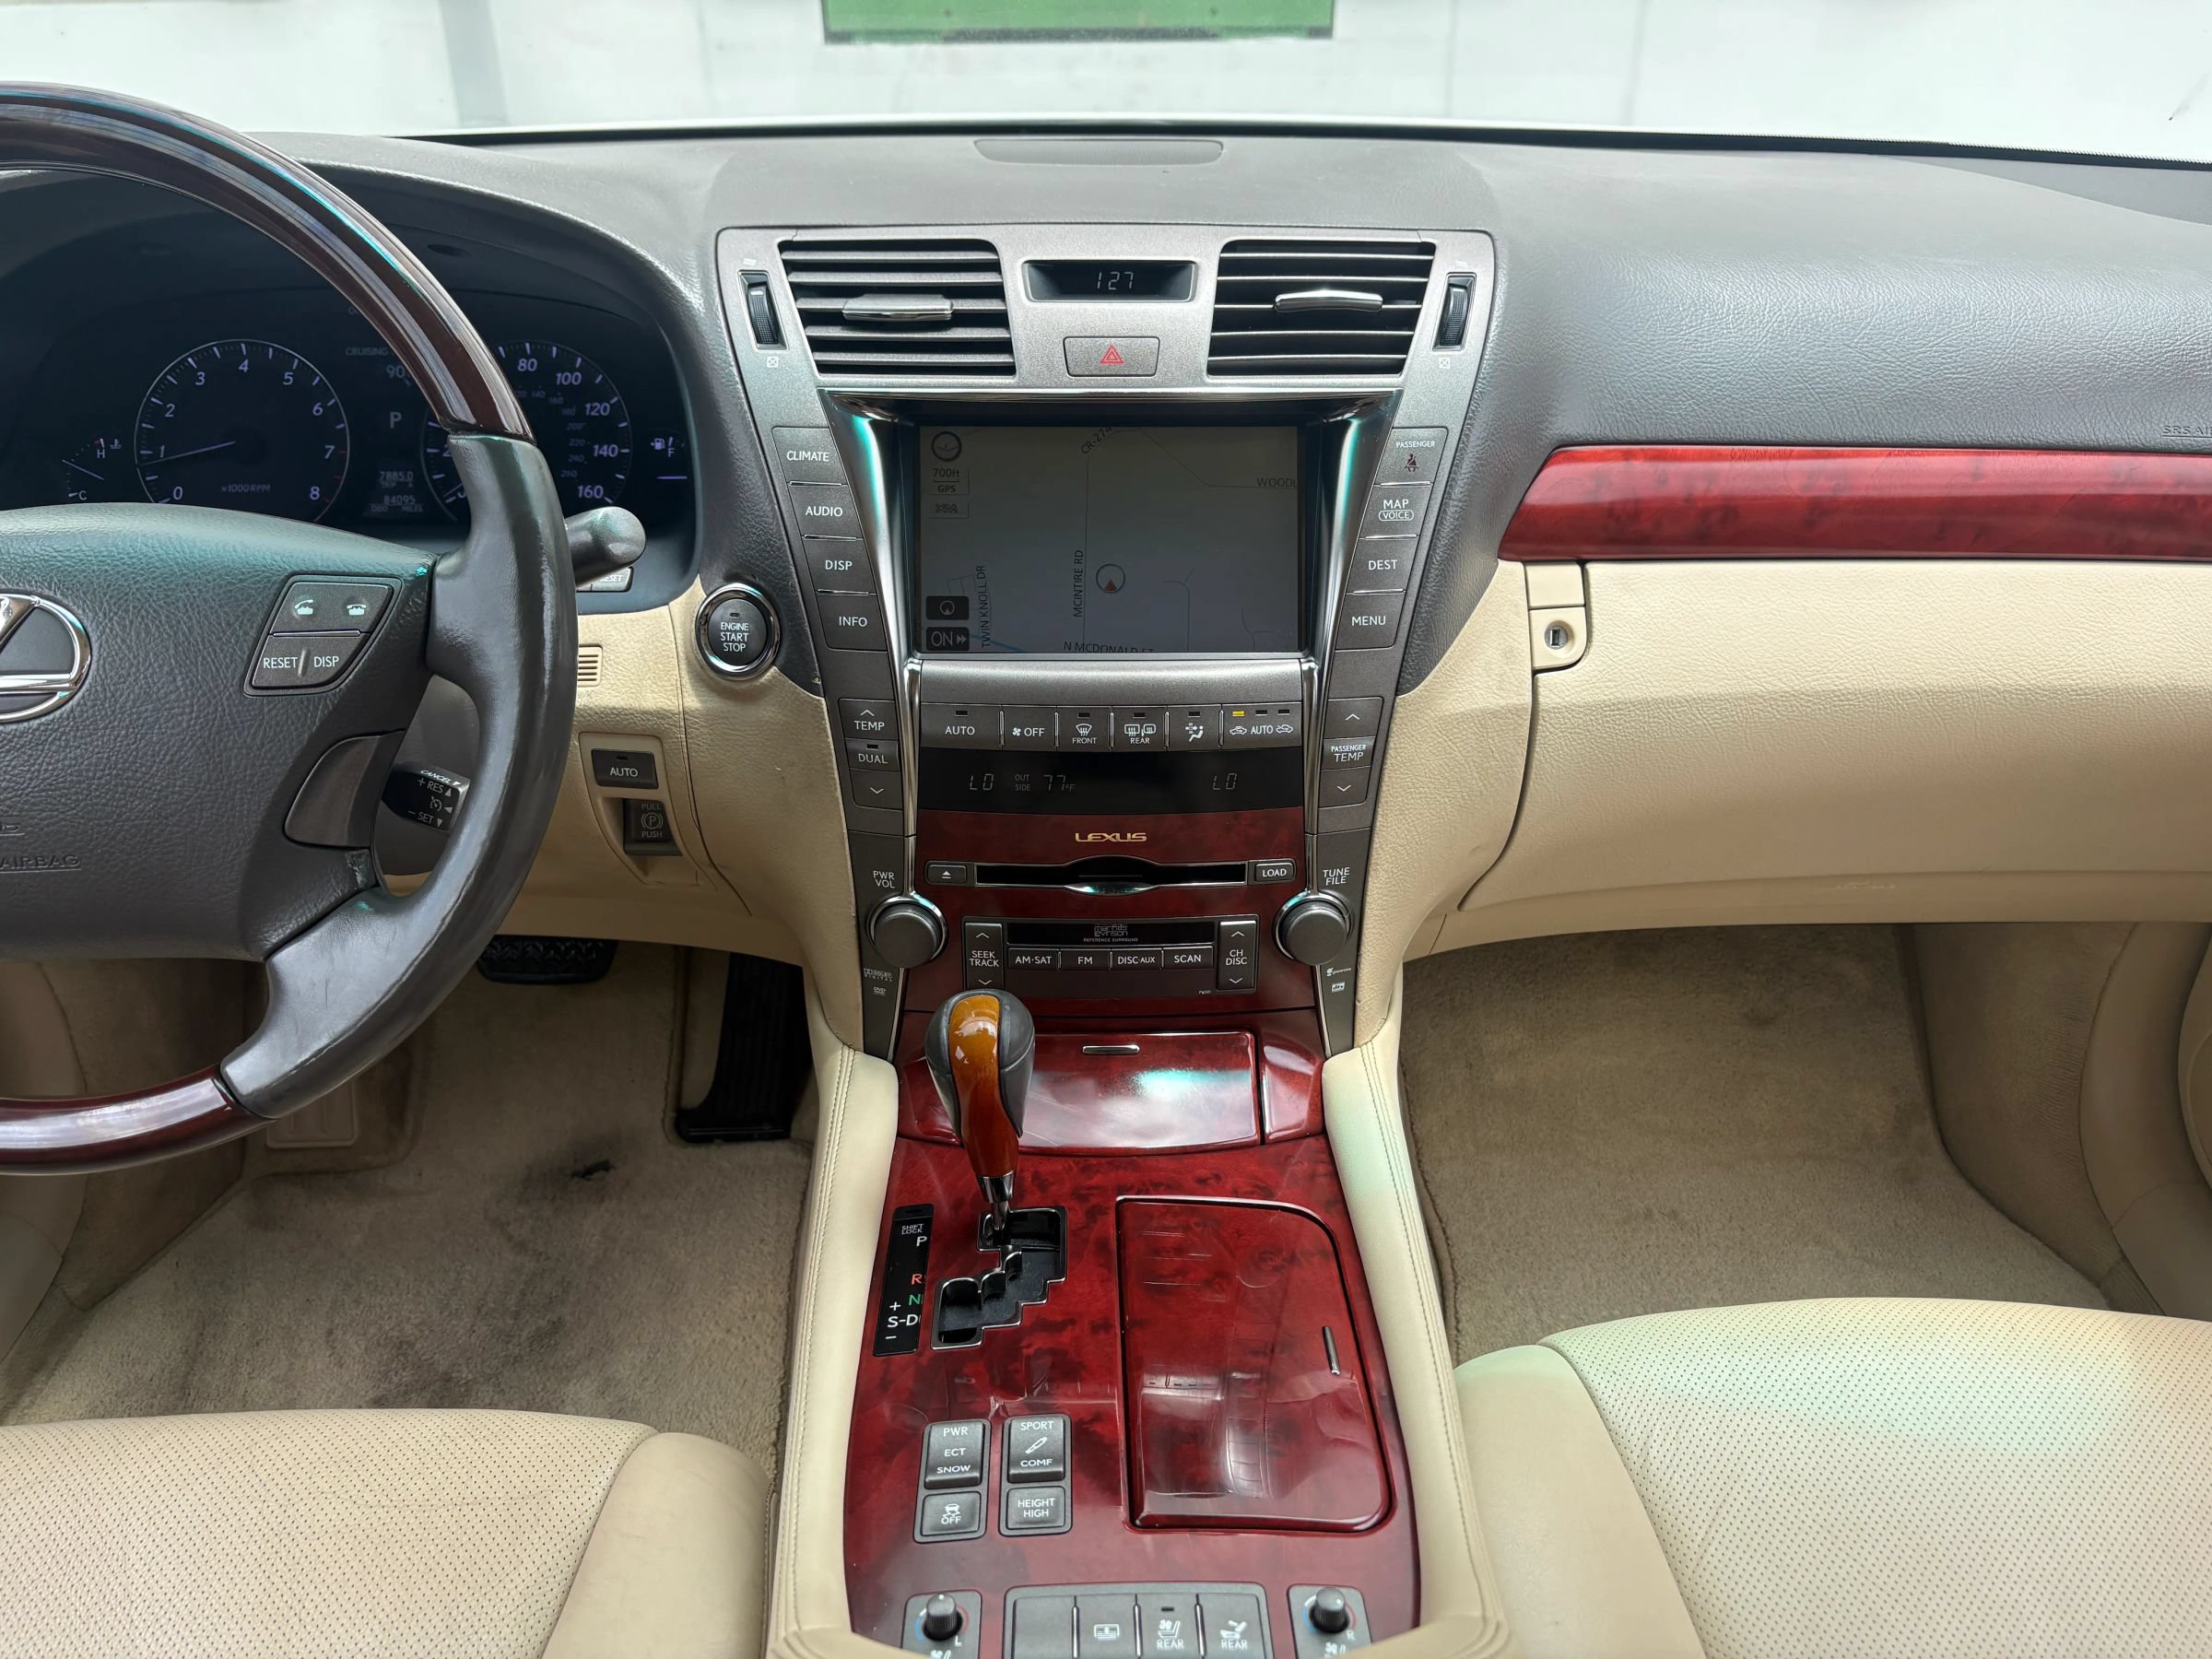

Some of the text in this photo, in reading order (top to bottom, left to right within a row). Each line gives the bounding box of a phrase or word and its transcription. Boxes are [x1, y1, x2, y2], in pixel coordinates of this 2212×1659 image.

[239, 359, 249, 372] 4
[517, 359, 538, 371] 80
[195, 372, 206, 385] 3
[283, 372, 294, 385] 5
[556, 372, 582, 385] 100
[165, 404, 175, 417] 2
[312, 403, 323, 416] 6
[584, 403, 610, 416] 120
[390, 412, 402, 428] P
[2163, 425, 2212, 435] SRS AI
[97, 449, 105, 458] H
[159, 445, 166, 457] 1
[324, 445, 335, 459] 7
[593, 444, 619, 457] 140
[667, 448, 675, 458] F
[786, 451, 830, 463] CLIMATE
[172, 487, 183, 500] 0
[310, 487, 320, 500] 8
[578, 486, 604, 499] 160
[937, 485, 957, 493] GPS
[79, 490, 87, 500] C
[1383, 499, 1409, 509] MAP
[806, 506, 843, 517] AUDIO
[1382, 511, 1410, 520] VOICE
[825, 559, 853, 571] DISP
[1368, 559, 1397, 571] DEST
[1073, 549, 1084, 618] MCINTIRE RD
[977, 565, 991, 648] TWIN KNOLL DR
[839, 616, 868, 628] INFO
[1351, 615, 1386, 626] MENU
[720, 622, 749, 631] ENGINE
[720, 632, 749, 642] START
[931, 630, 953, 646] ON
[723, 642, 746, 653] STOP
[1064, 641, 1072, 651] N
[264, 656, 298, 669] RESET
[313, 655, 340, 668] DISP
[854, 720, 886, 731] TEMP
[945, 726, 975, 735] AUTO
[1251, 725, 1274, 735] AUTO
[1024, 727, 1045, 736] OFF
[1331, 744, 1367, 752] PASSENGER
[858, 753, 888, 764] DUAL
[1334, 752, 1364, 762] TEMP
[420, 770, 453, 784] CANCEL
[609, 767, 639, 778] AUTO
[427, 781, 444, 794] RES
[641, 803, 663, 811] PULL
[418, 811, 434, 825] SET
[641, 830, 663, 839] PUSH
[1076, 832, 1147, 842] LEXUS
[0, 854, 81, 869] AIRBAG
[873, 870, 895, 881] PWR
[1263, 868, 1287, 877] LOAD
[1323, 867, 1350, 877] TUNE
[876, 878, 895, 888] VOL
[1325, 876, 1347, 886] FILE
[972, 950, 995, 959] SEEK
[1174, 954, 1201, 963] SCAN
[1230, 949, 1243, 958] CH
[970, 958, 1000, 968] TRACK
[1077, 957, 1093, 965] FM
[1226, 957, 1248, 966] DISC
[916, 1236, 927, 1247] P
[912, 1273, 923, 1285] R
[909, 1293, 921, 1305] N
[1020, 1420, 1054, 1430] SPORT
[943, 1427, 968, 1437] PWR
[944, 1448, 966, 1457] ECT
[1020, 1459, 1053, 1467] COMF
[936, 1465, 971, 1474] SNOW
[1018, 1498, 1055, 1508] HEIGHT
[1023, 1509, 1049, 1519] HIGH
[941, 1515, 962, 1525] OFF
[1157, 1640, 1184, 1650] REAR
[1221, 1640, 1247, 1650] REAR
